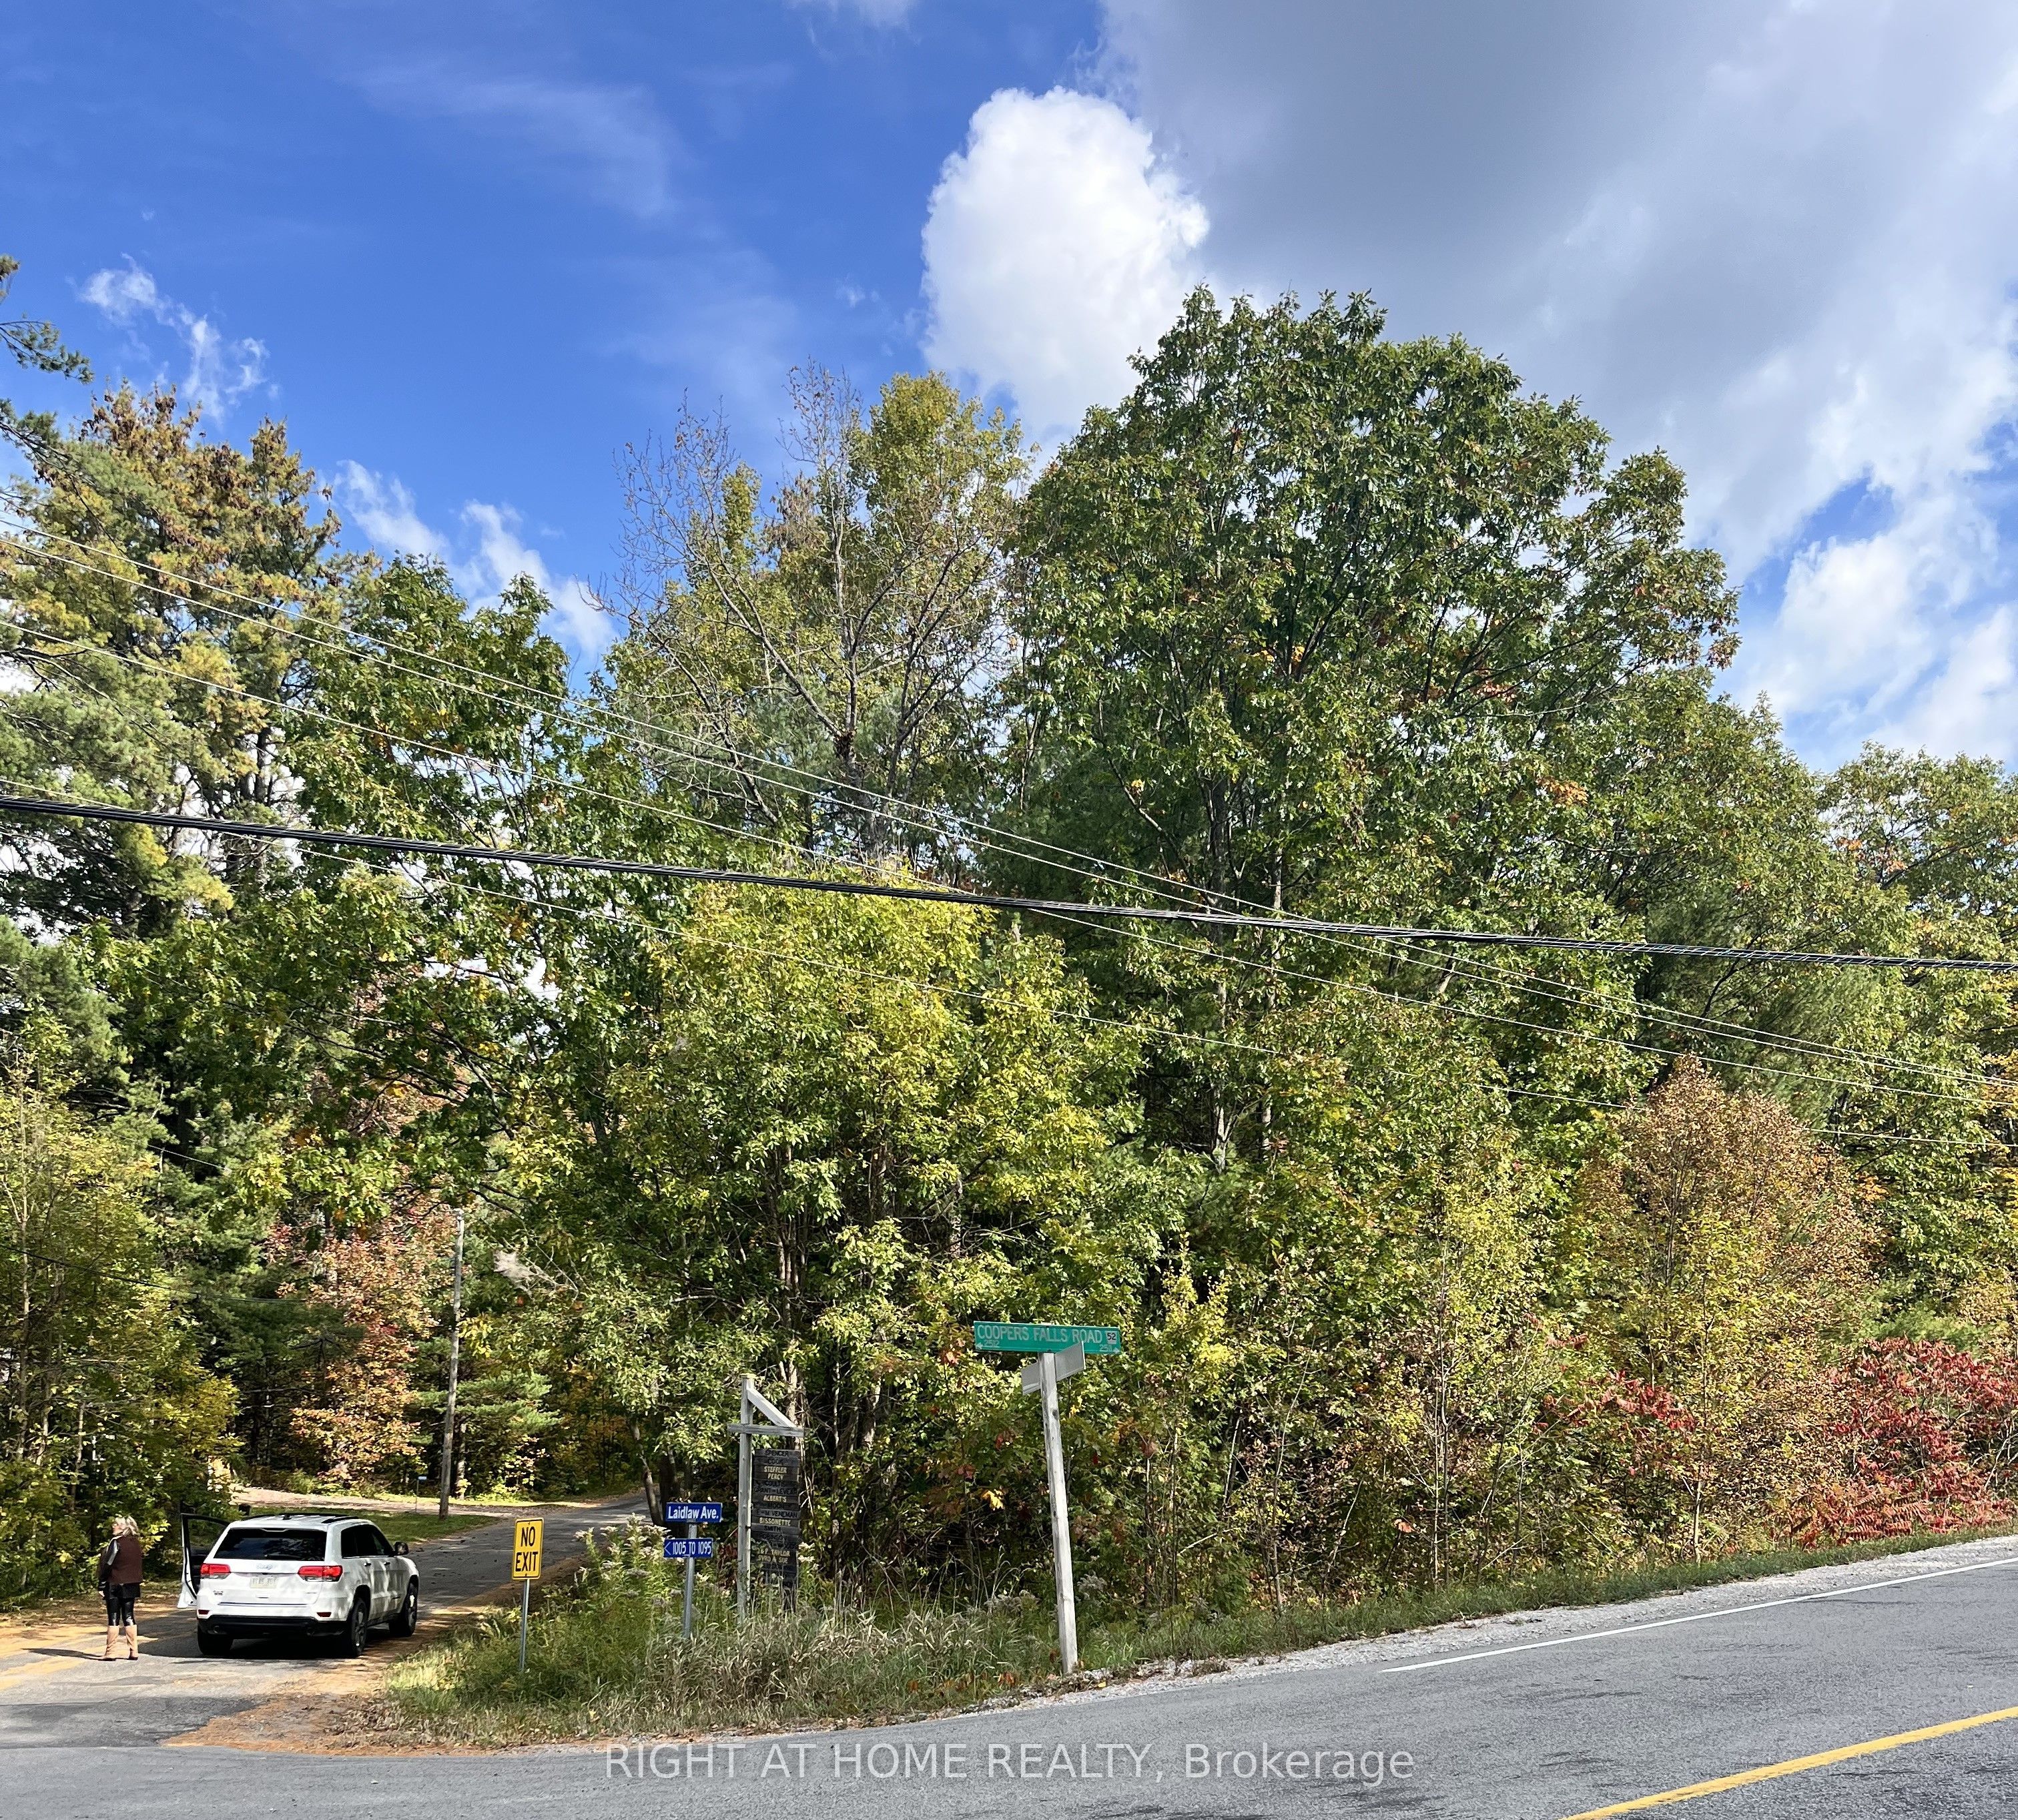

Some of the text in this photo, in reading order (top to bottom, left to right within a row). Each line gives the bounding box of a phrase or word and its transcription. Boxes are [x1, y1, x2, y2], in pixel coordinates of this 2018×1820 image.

[977, 1325, 1102, 1343] COOPERS FALLS ROAD
[1107, 1333, 1116, 1341] 52
[764, 1466, 787, 1474] STEFFLER
[668, 1506, 719, 1519] Laidlaw Ave.
[759, 1517, 791, 1526] BISSONETTE
[521, 1526, 536, 1547] NO
[673, 1541, 711, 1555] 1005 TO 1095
[515, 1552, 539, 1572] EXIT
